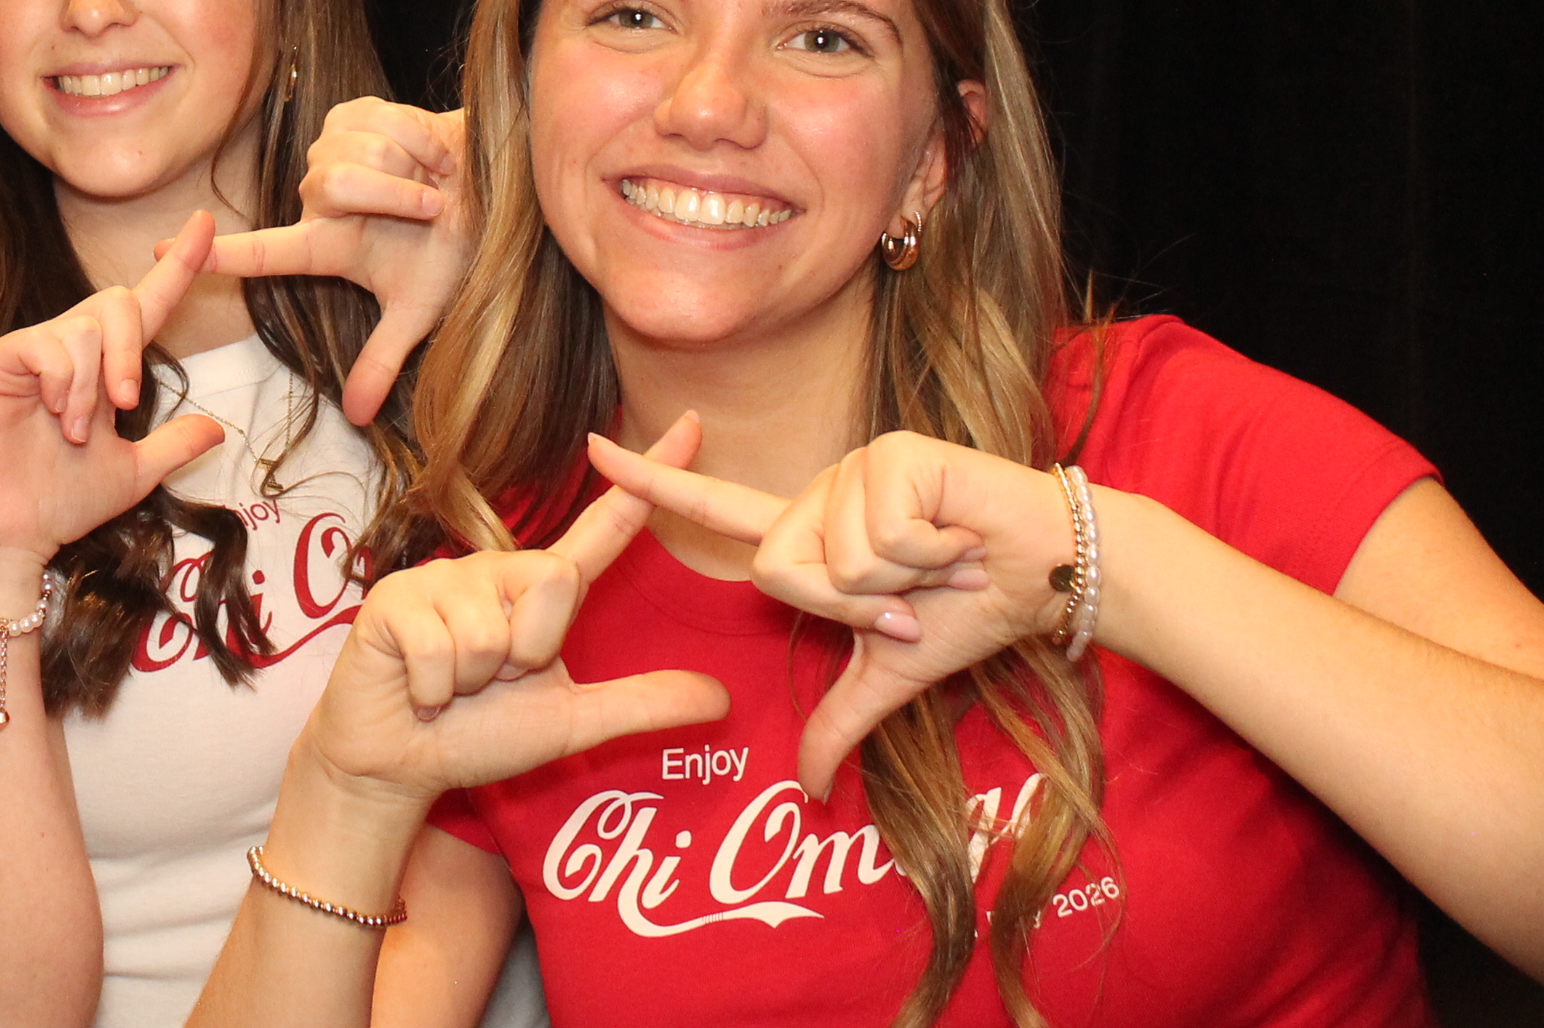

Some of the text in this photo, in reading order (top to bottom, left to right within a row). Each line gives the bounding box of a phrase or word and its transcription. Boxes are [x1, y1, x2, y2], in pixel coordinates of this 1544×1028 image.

[661, 744, 749, 785] Enjoy
[542, 772, 1048, 937] Chi Omg
[1052, 876, 1120, 918] 2026
